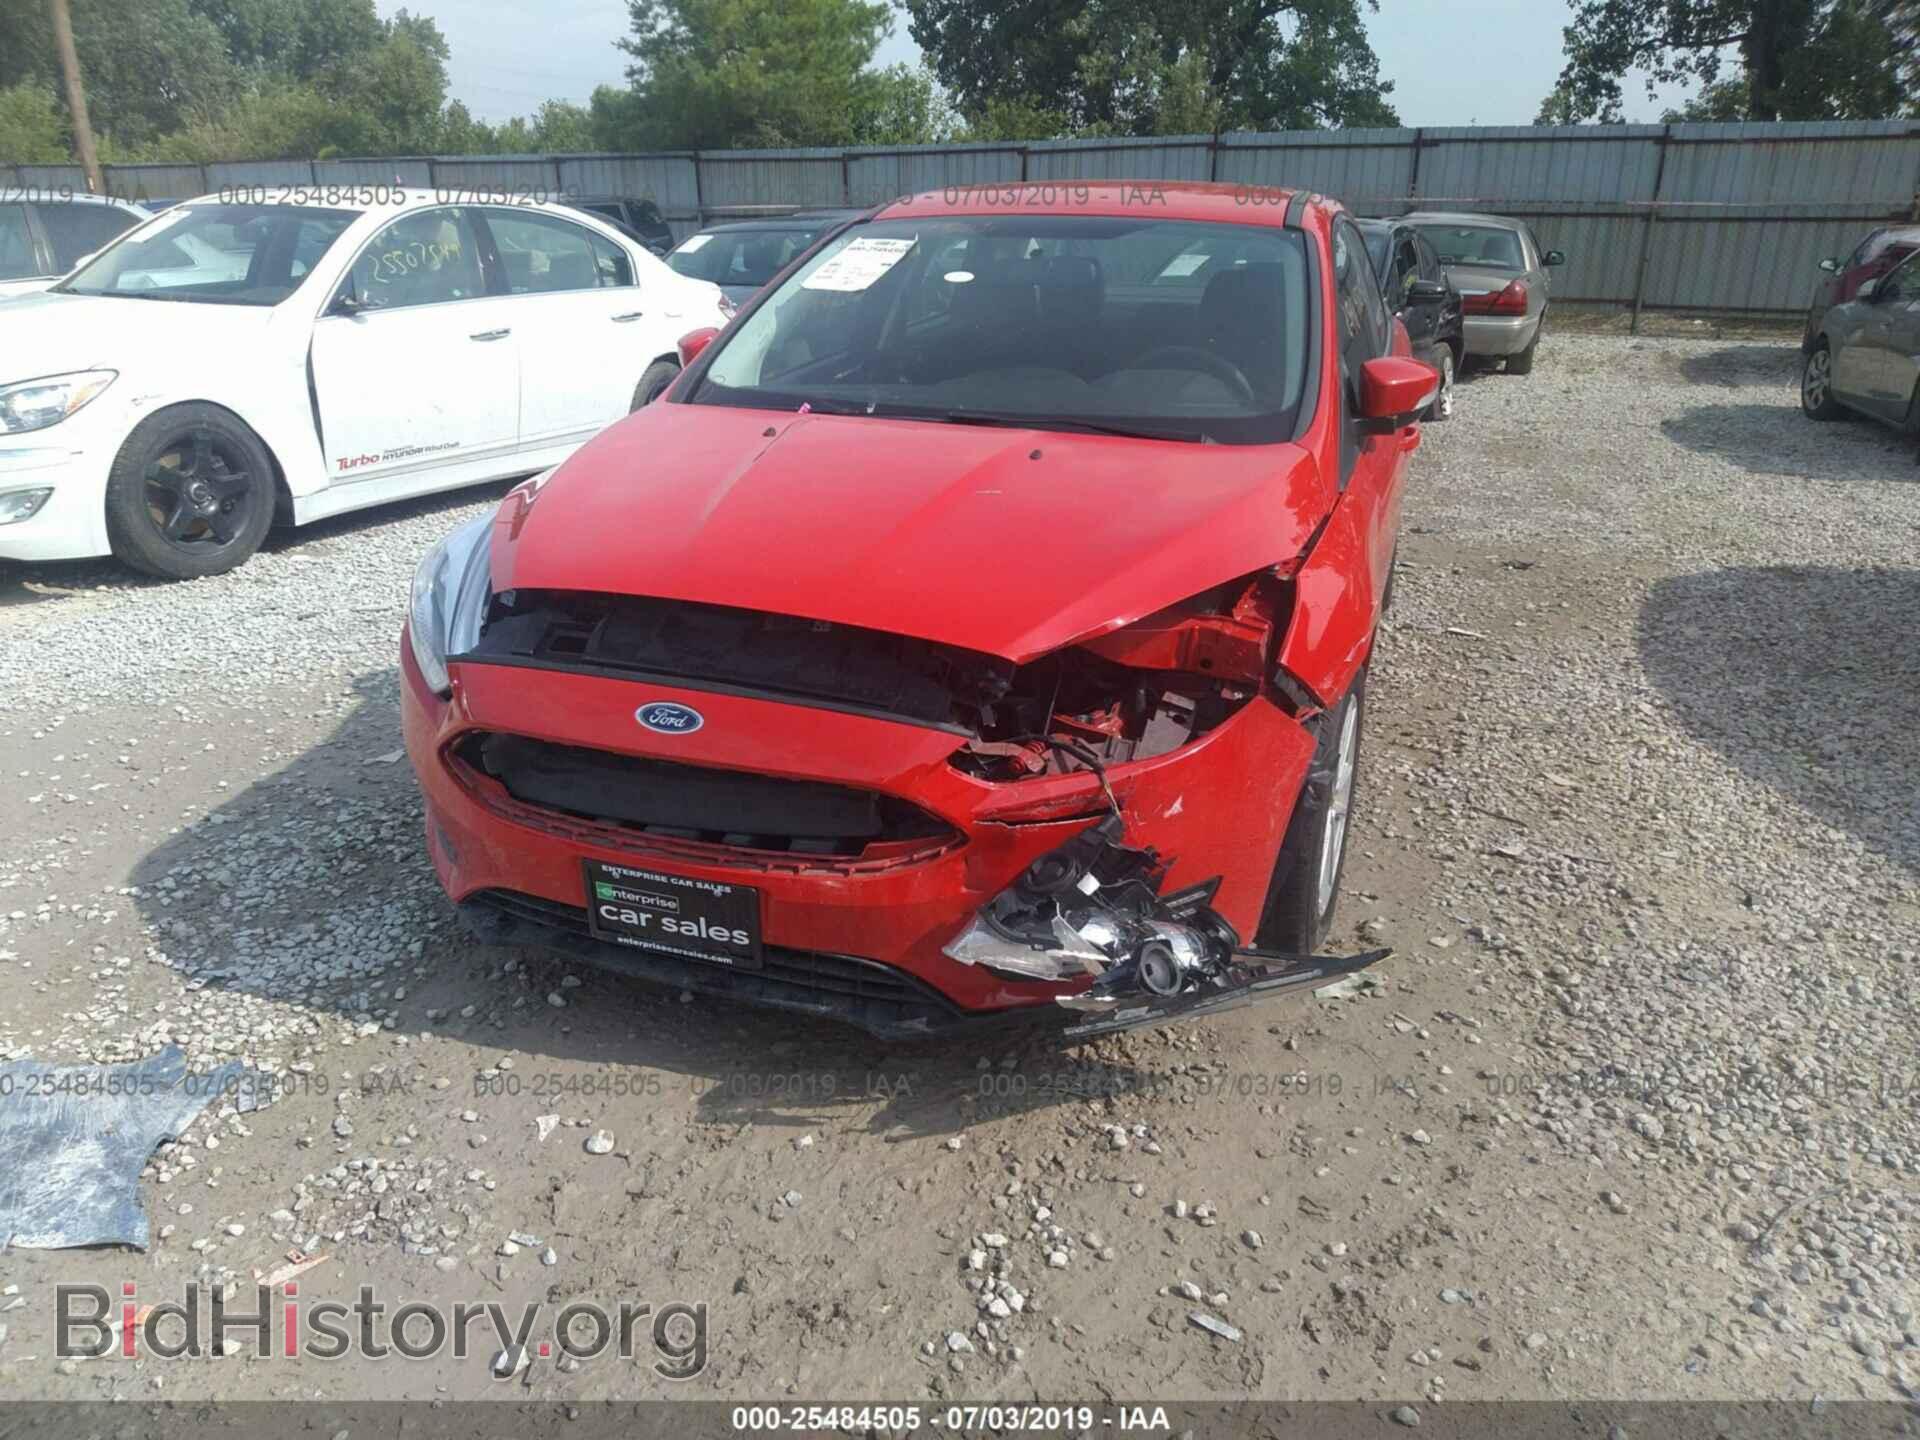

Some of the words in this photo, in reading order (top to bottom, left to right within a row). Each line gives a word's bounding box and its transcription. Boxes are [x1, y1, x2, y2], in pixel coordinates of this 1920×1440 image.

[336, 454, 380, 471] Turbo
[649, 707, 688, 727] Ford
[601, 864, 668, 883] ENTERPRISE
[670, 877, 693, 888] CAR
[696, 881, 732, 894] SALES
[599, 886, 677, 909] enterprise
[600, 905, 652, 927] car
[661, 917, 750, 945] sales
[617, 936, 733, 964] enterprisecarsales.com
